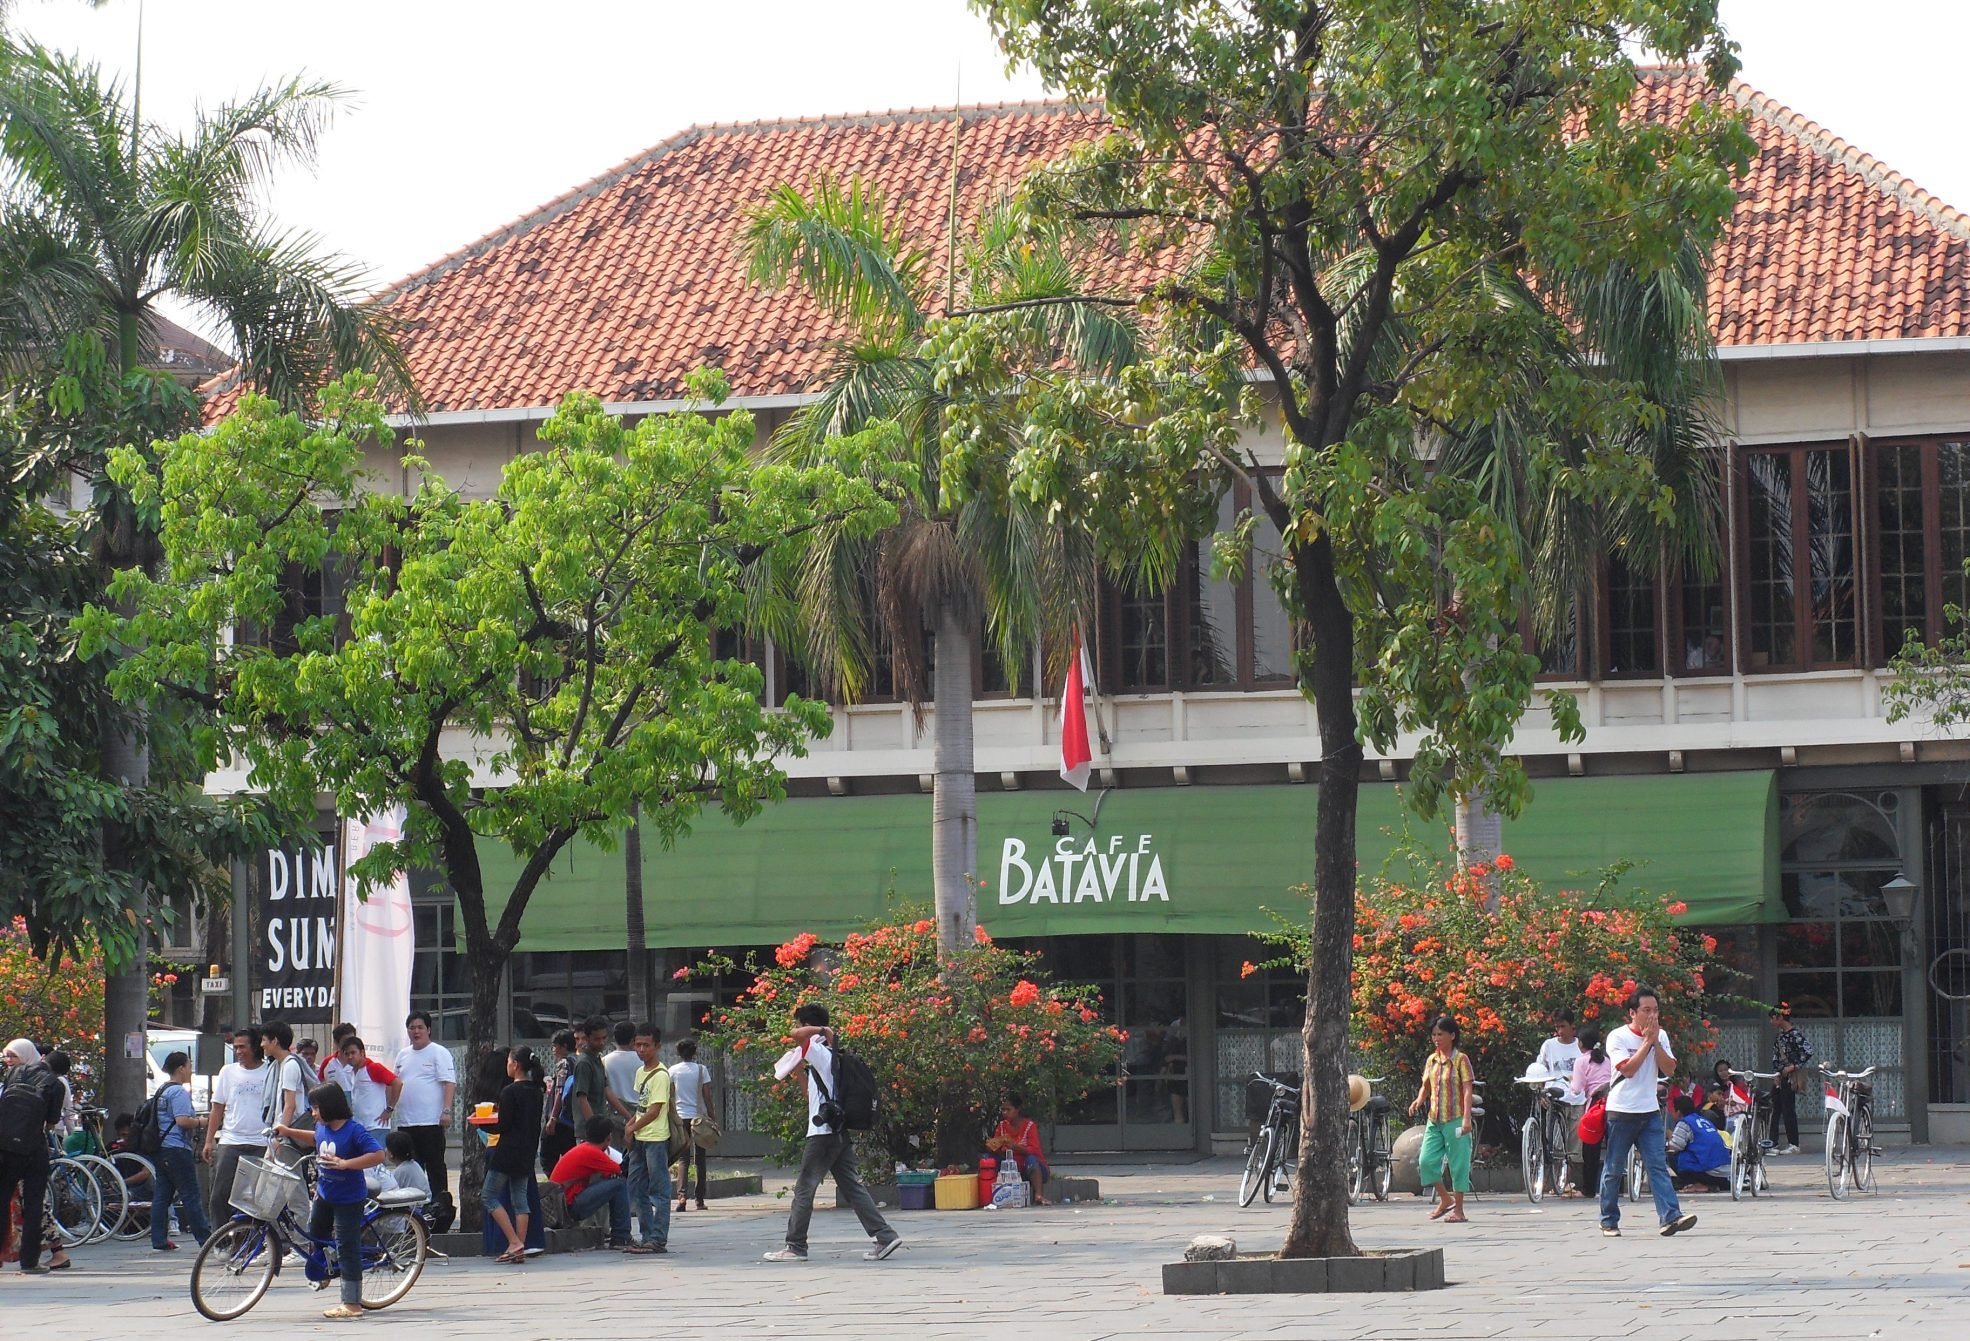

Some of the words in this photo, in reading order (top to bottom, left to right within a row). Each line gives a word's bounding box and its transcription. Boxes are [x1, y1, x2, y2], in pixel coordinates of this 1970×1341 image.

[1055, 834, 1153, 856] CAFE
[267, 845, 336, 901] DIM
[998, 837, 1170, 905] BATAVIA
[205, 981, 223, 989] TAXI
